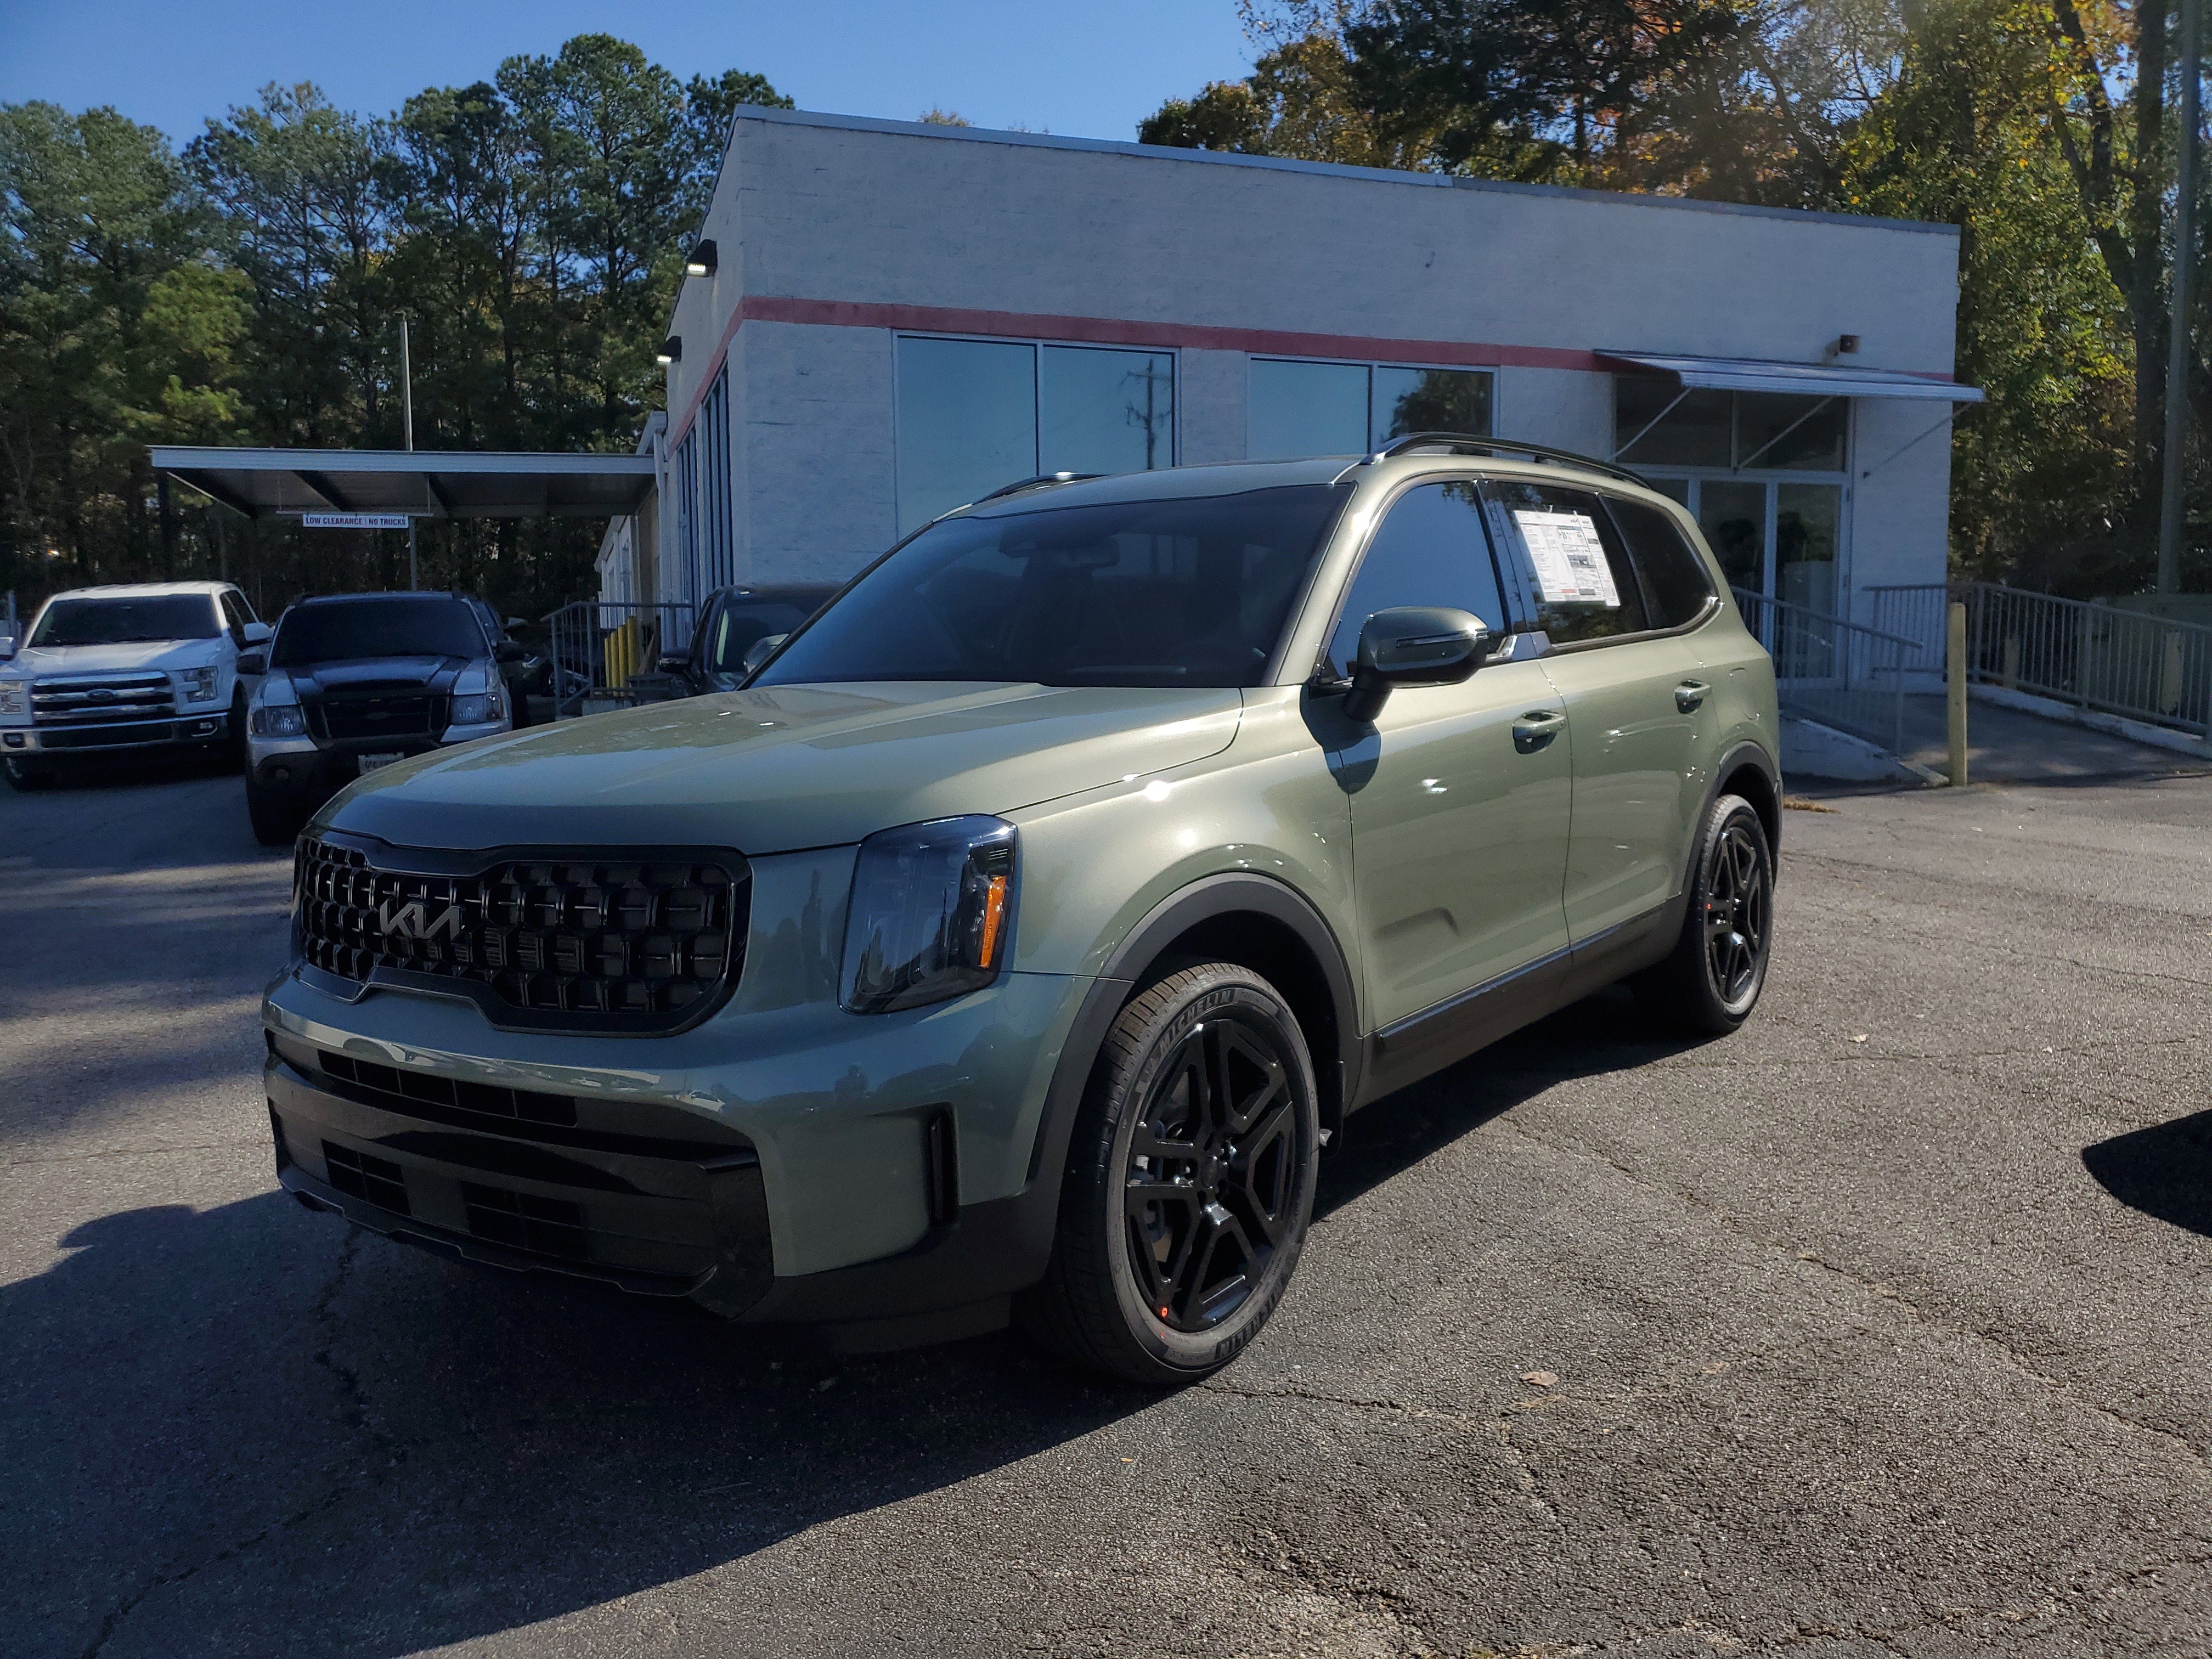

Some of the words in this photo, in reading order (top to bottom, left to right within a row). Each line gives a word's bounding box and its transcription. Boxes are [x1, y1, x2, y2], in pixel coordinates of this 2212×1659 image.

[323, 517, 363, 526] CLEARANCE
[380, 899, 460, 941] KIA
[1159, 989, 1232, 1056] MICHELIN
